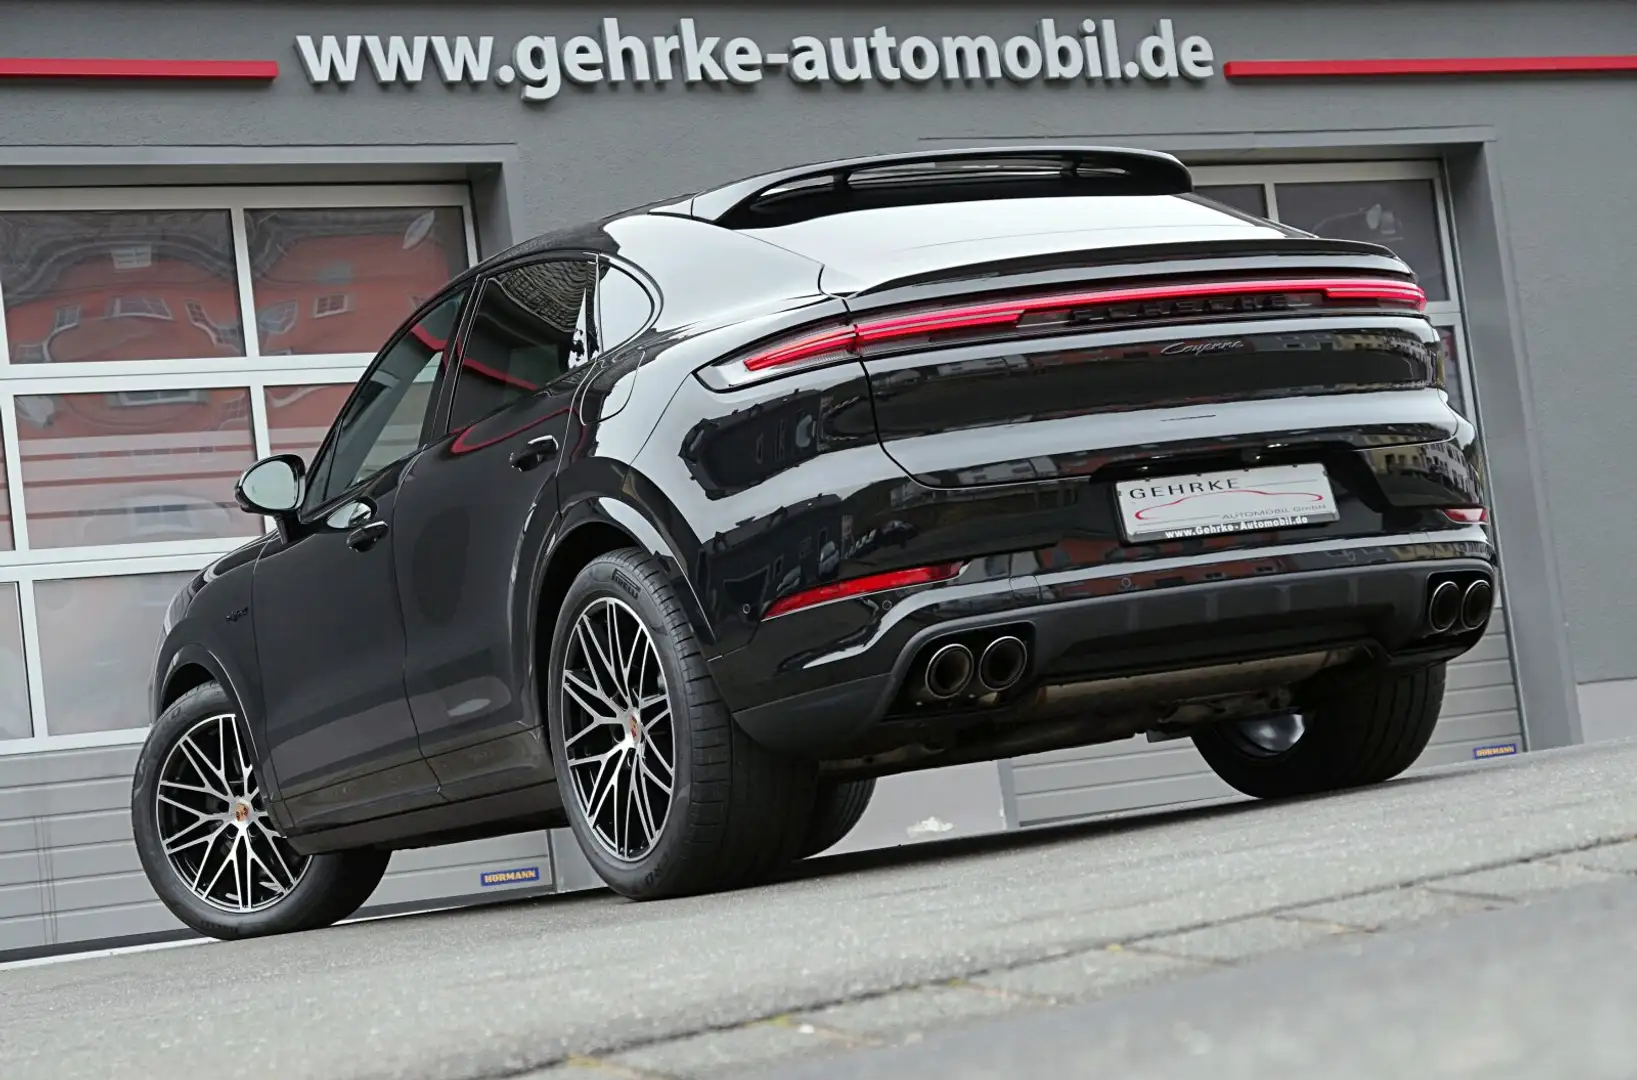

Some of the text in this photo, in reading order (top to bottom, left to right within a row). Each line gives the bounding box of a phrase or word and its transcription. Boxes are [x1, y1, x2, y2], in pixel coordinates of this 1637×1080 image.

[296, 17, 1215, 100] www.gehrke-automobil.de
[1160, 340, 1244, 357] Cayenne
[1129, 478, 1241, 500] GEHRKE
[1221, 507, 1290, 520] AUTOMOBIL
